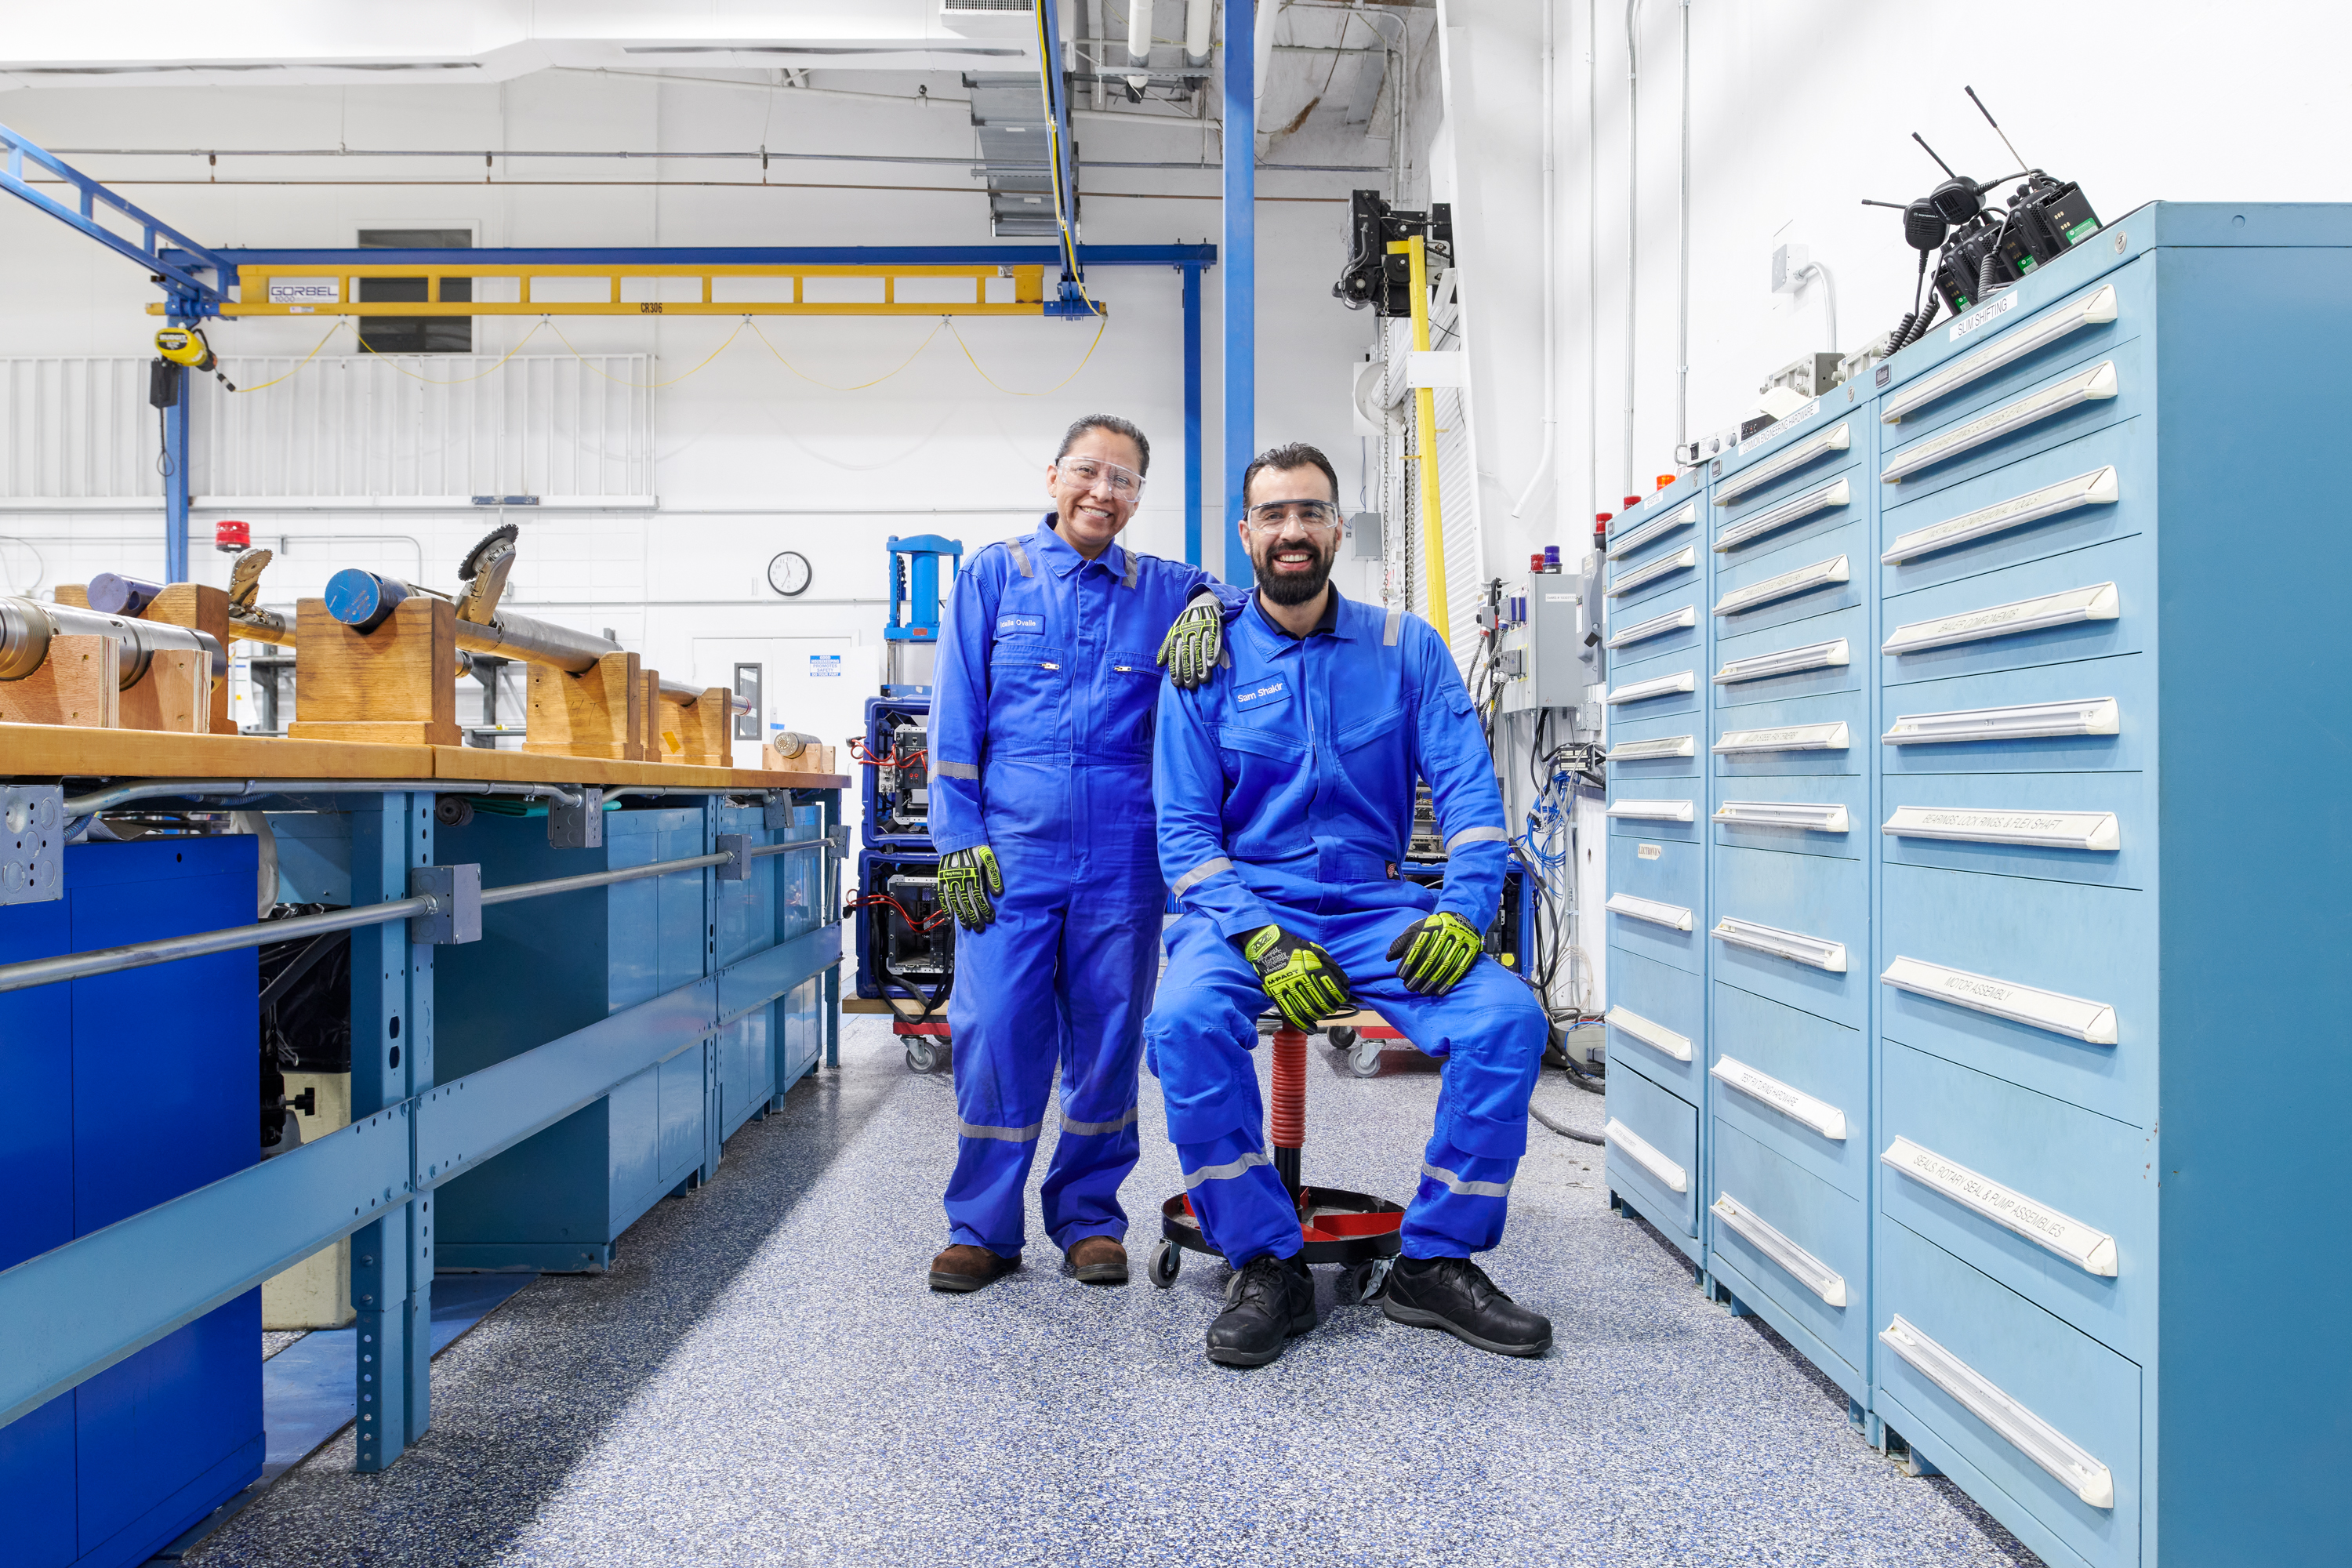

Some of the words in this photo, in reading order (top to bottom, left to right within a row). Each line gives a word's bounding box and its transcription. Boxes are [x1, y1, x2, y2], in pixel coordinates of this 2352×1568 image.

[271, 286, 338, 296] GORBEL
[641, 302, 662, 314] CR306
[1958, 317, 1974, 336] SLIM
[1975, 298, 2007, 326] SHIFTING
[1742, 435, 1762, 453] COMMON
[1760, 419, 1788, 444] ENGINEERING
[1788, 405, 1813, 426] HARDWARE
[2009, 494, 2042, 511] TOOLS
[1963, 608, 2019, 628] COMPONENTS
[1237, 692, 1257, 702] Sam
[1258, 683, 1283, 696] Shakir
[1957, 815, 1980, 826] LOCK
[2002, 818, 2013, 828] &
[2011, 818, 2034, 829] FLEX
[2031, 818, 2063, 830] SHAFT
[1639, 846, 1661, 856] LECTRONICS
[1944, 976, 1973, 992] MOTOR
[1969, 983, 2014, 1002] ASSEMBLY
[1740, 1073, 1753, 1083] TEST
[1750, 1077, 1774, 1094] FIXTURING
[1770, 1087, 1798, 1107] HARDWARE
[1913, 1154, 1938, 1173] SEALS,
[1935, 1166, 1968, 1187] ROTARY
[1963, 1180, 1985, 1197] SEAL
[1982, 1189, 1992, 1200] &
[1988, 1192, 2015, 1212] PUMP
[2012, 1204, 2065, 1238] ASSEMBLIES
